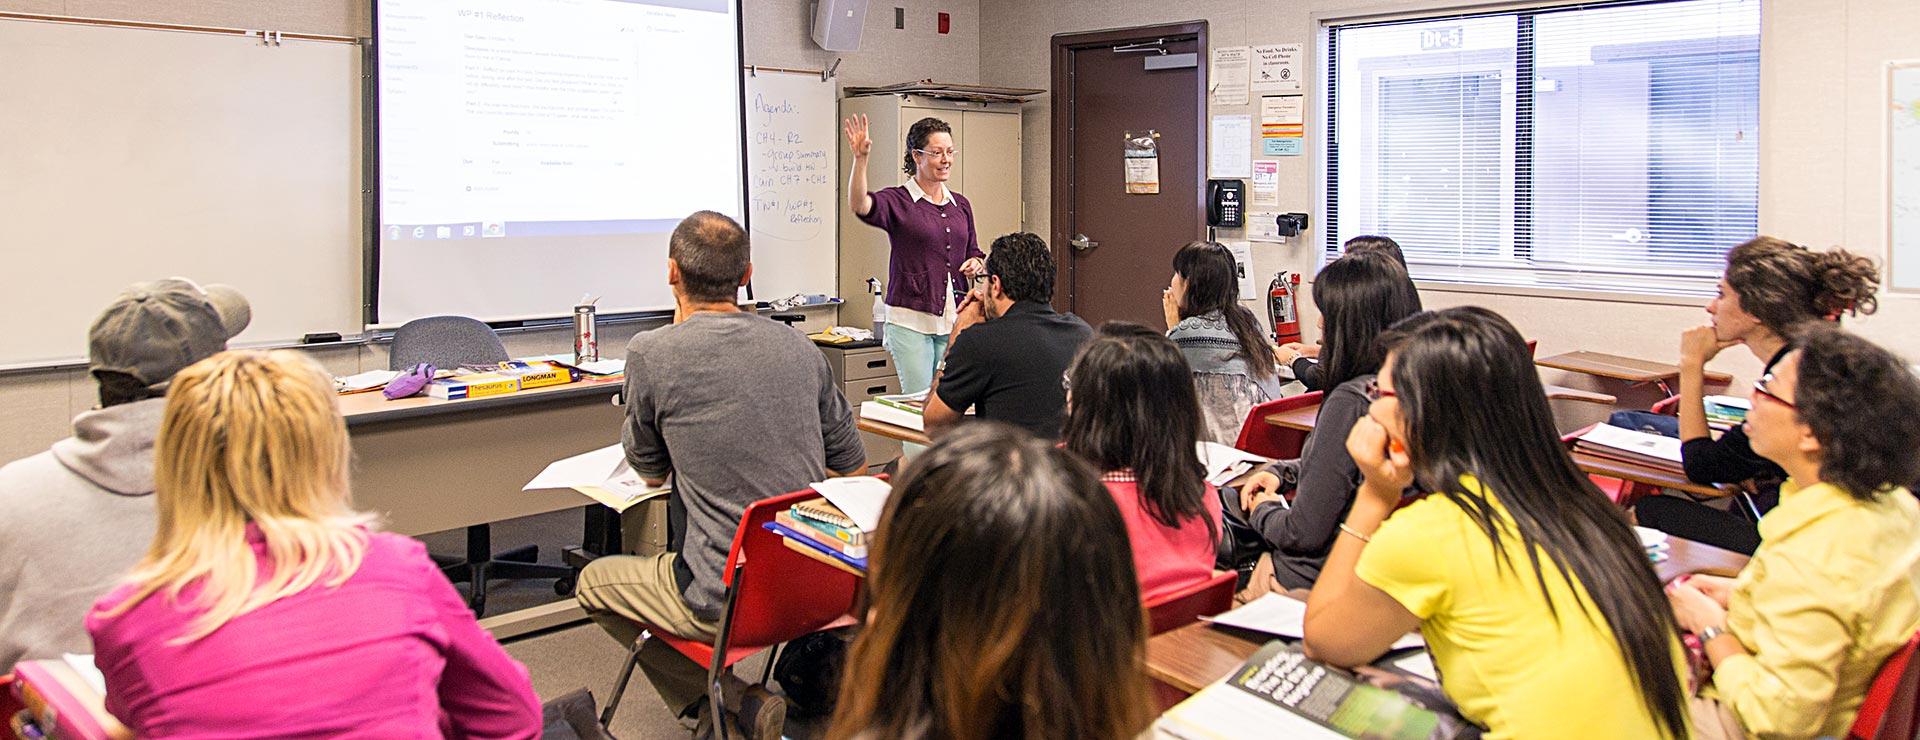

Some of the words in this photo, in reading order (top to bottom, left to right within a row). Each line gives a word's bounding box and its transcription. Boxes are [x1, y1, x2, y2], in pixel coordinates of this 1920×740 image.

[486, 12, 524, 23] Reflection
[522, 373, 556, 382] LONGMAN
[470, 383, 502, 391] Thesaurus
